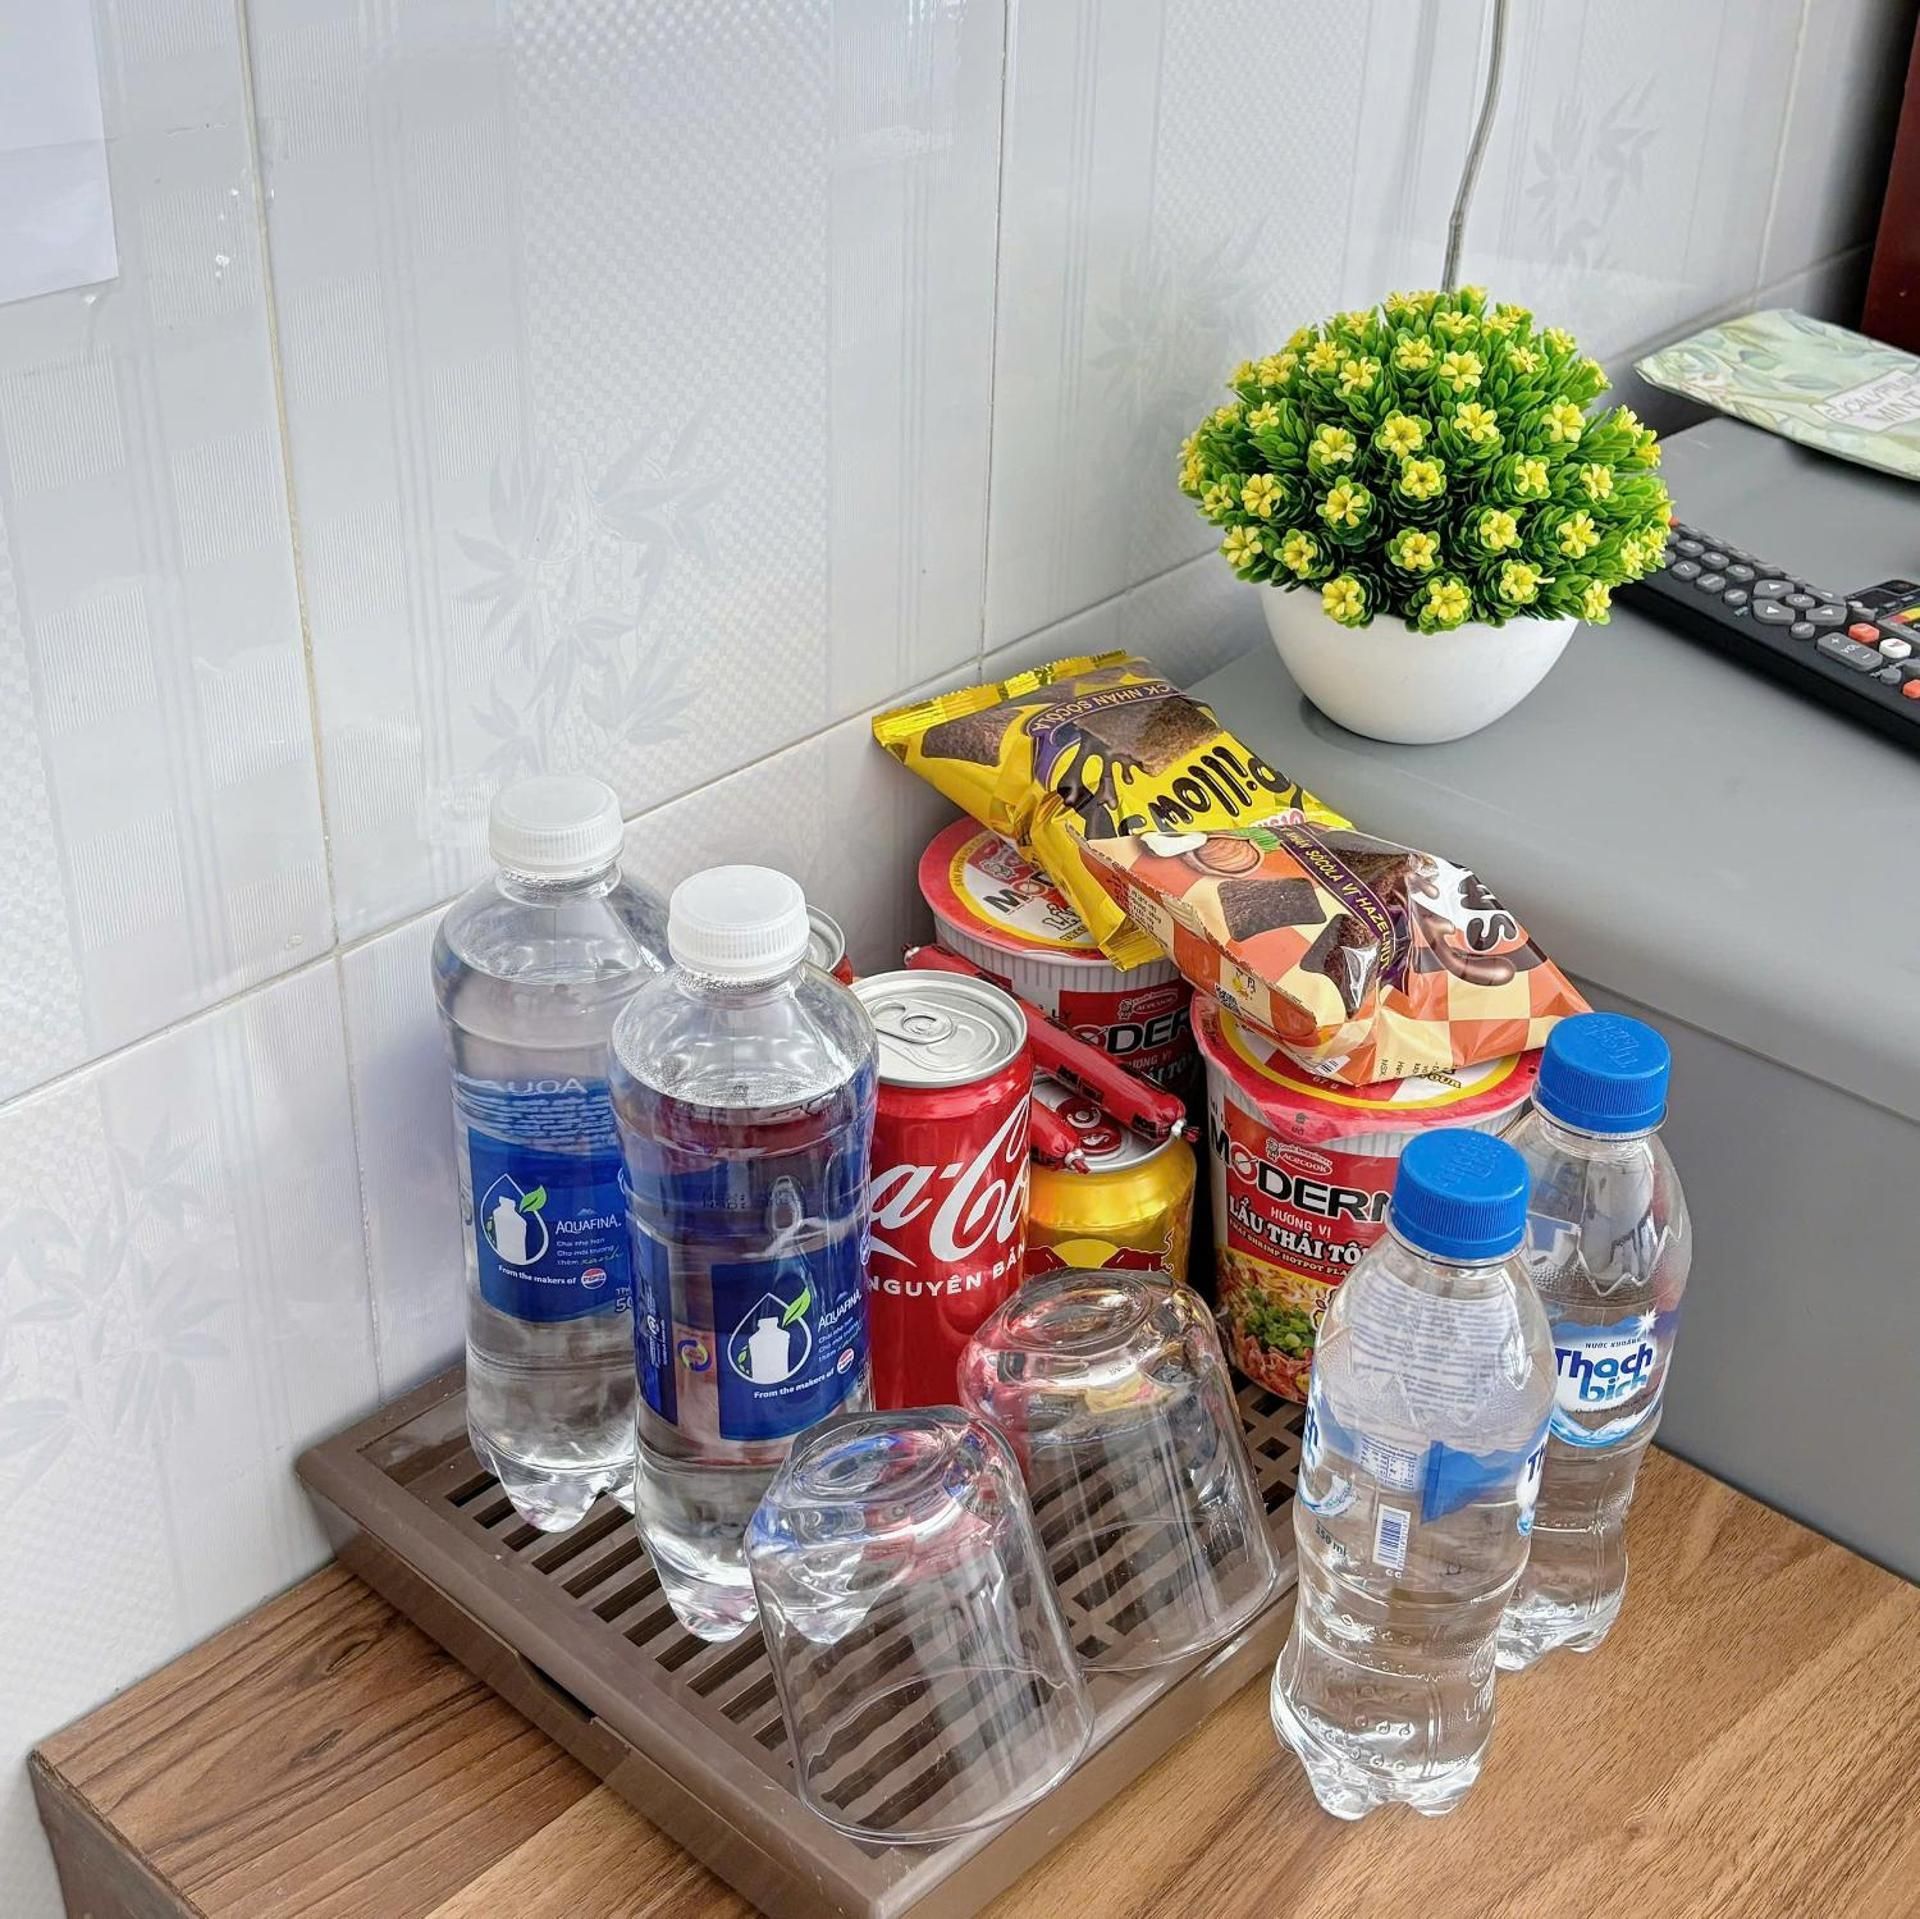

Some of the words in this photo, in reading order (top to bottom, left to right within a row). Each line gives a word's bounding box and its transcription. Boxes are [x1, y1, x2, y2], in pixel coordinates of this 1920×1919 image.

[1355, 896, 1392, 970] HAZELNUT
[1270, 1206, 1314, 1233] HƯƠNG
[1247, 1233, 1281, 1257] SHRIMP
[1282, 1254, 1326, 1273] HOTPOT
[1266, 1220, 1325, 1260] THÁI
[1328, 1240, 1369, 1264] TÔ
[498, 1264, 518, 1278] From
[519, 1271, 532, 1281] the
[534, 1275, 566, 1285] makers
[567, 1276, 577, 1285] of
[753, 1390, 778, 1399] From
[779, 1385, 795, 1395] the
[795, 1375, 827, 1391] makers
[826, 1367, 835, 1378] of
